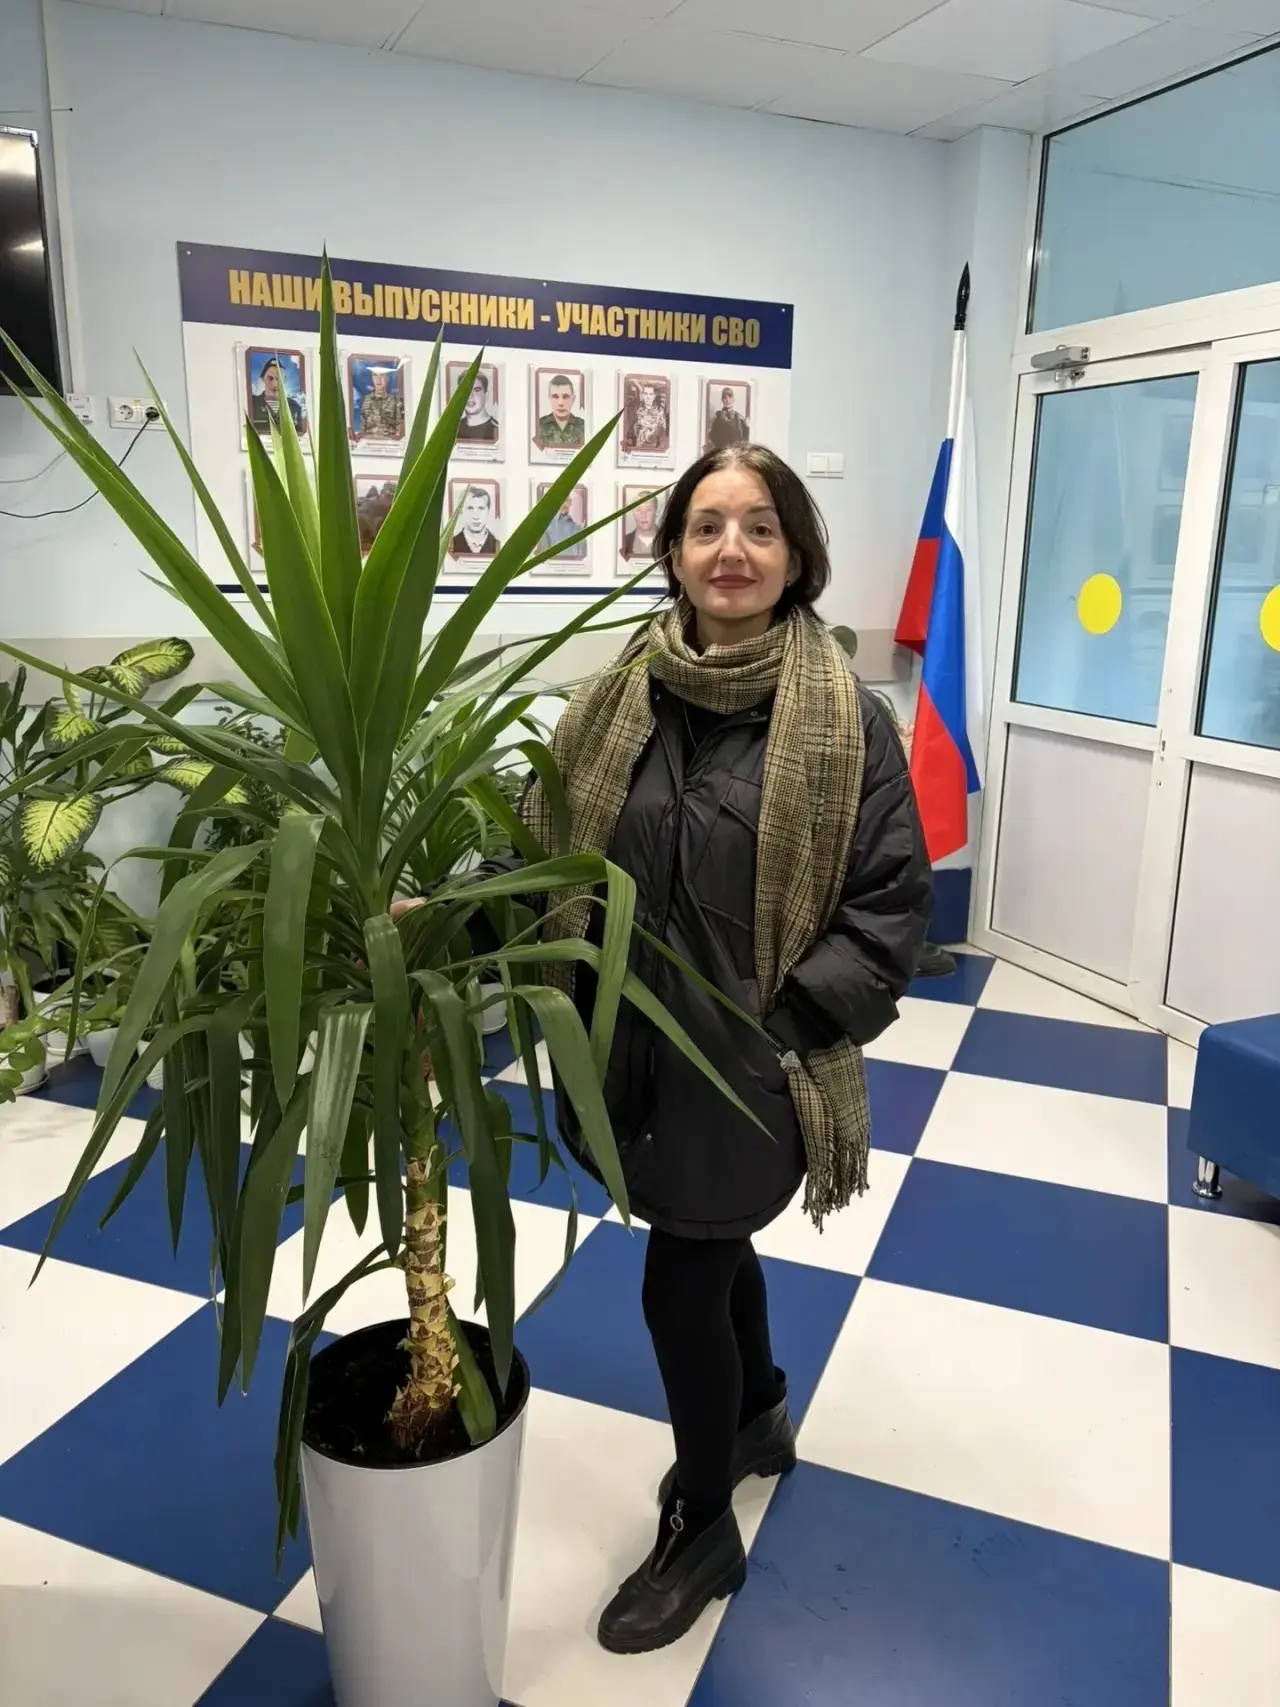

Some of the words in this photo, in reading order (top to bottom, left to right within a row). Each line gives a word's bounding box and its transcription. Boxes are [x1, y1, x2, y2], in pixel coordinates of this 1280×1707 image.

[228, 269, 322, 311] НАШИ
[333, 280, 534, 330] ВЫПУСКНИКИ
[556, 301, 706, 343] УЧАСТНИКИ
[712, 315, 761, 349] СВО
